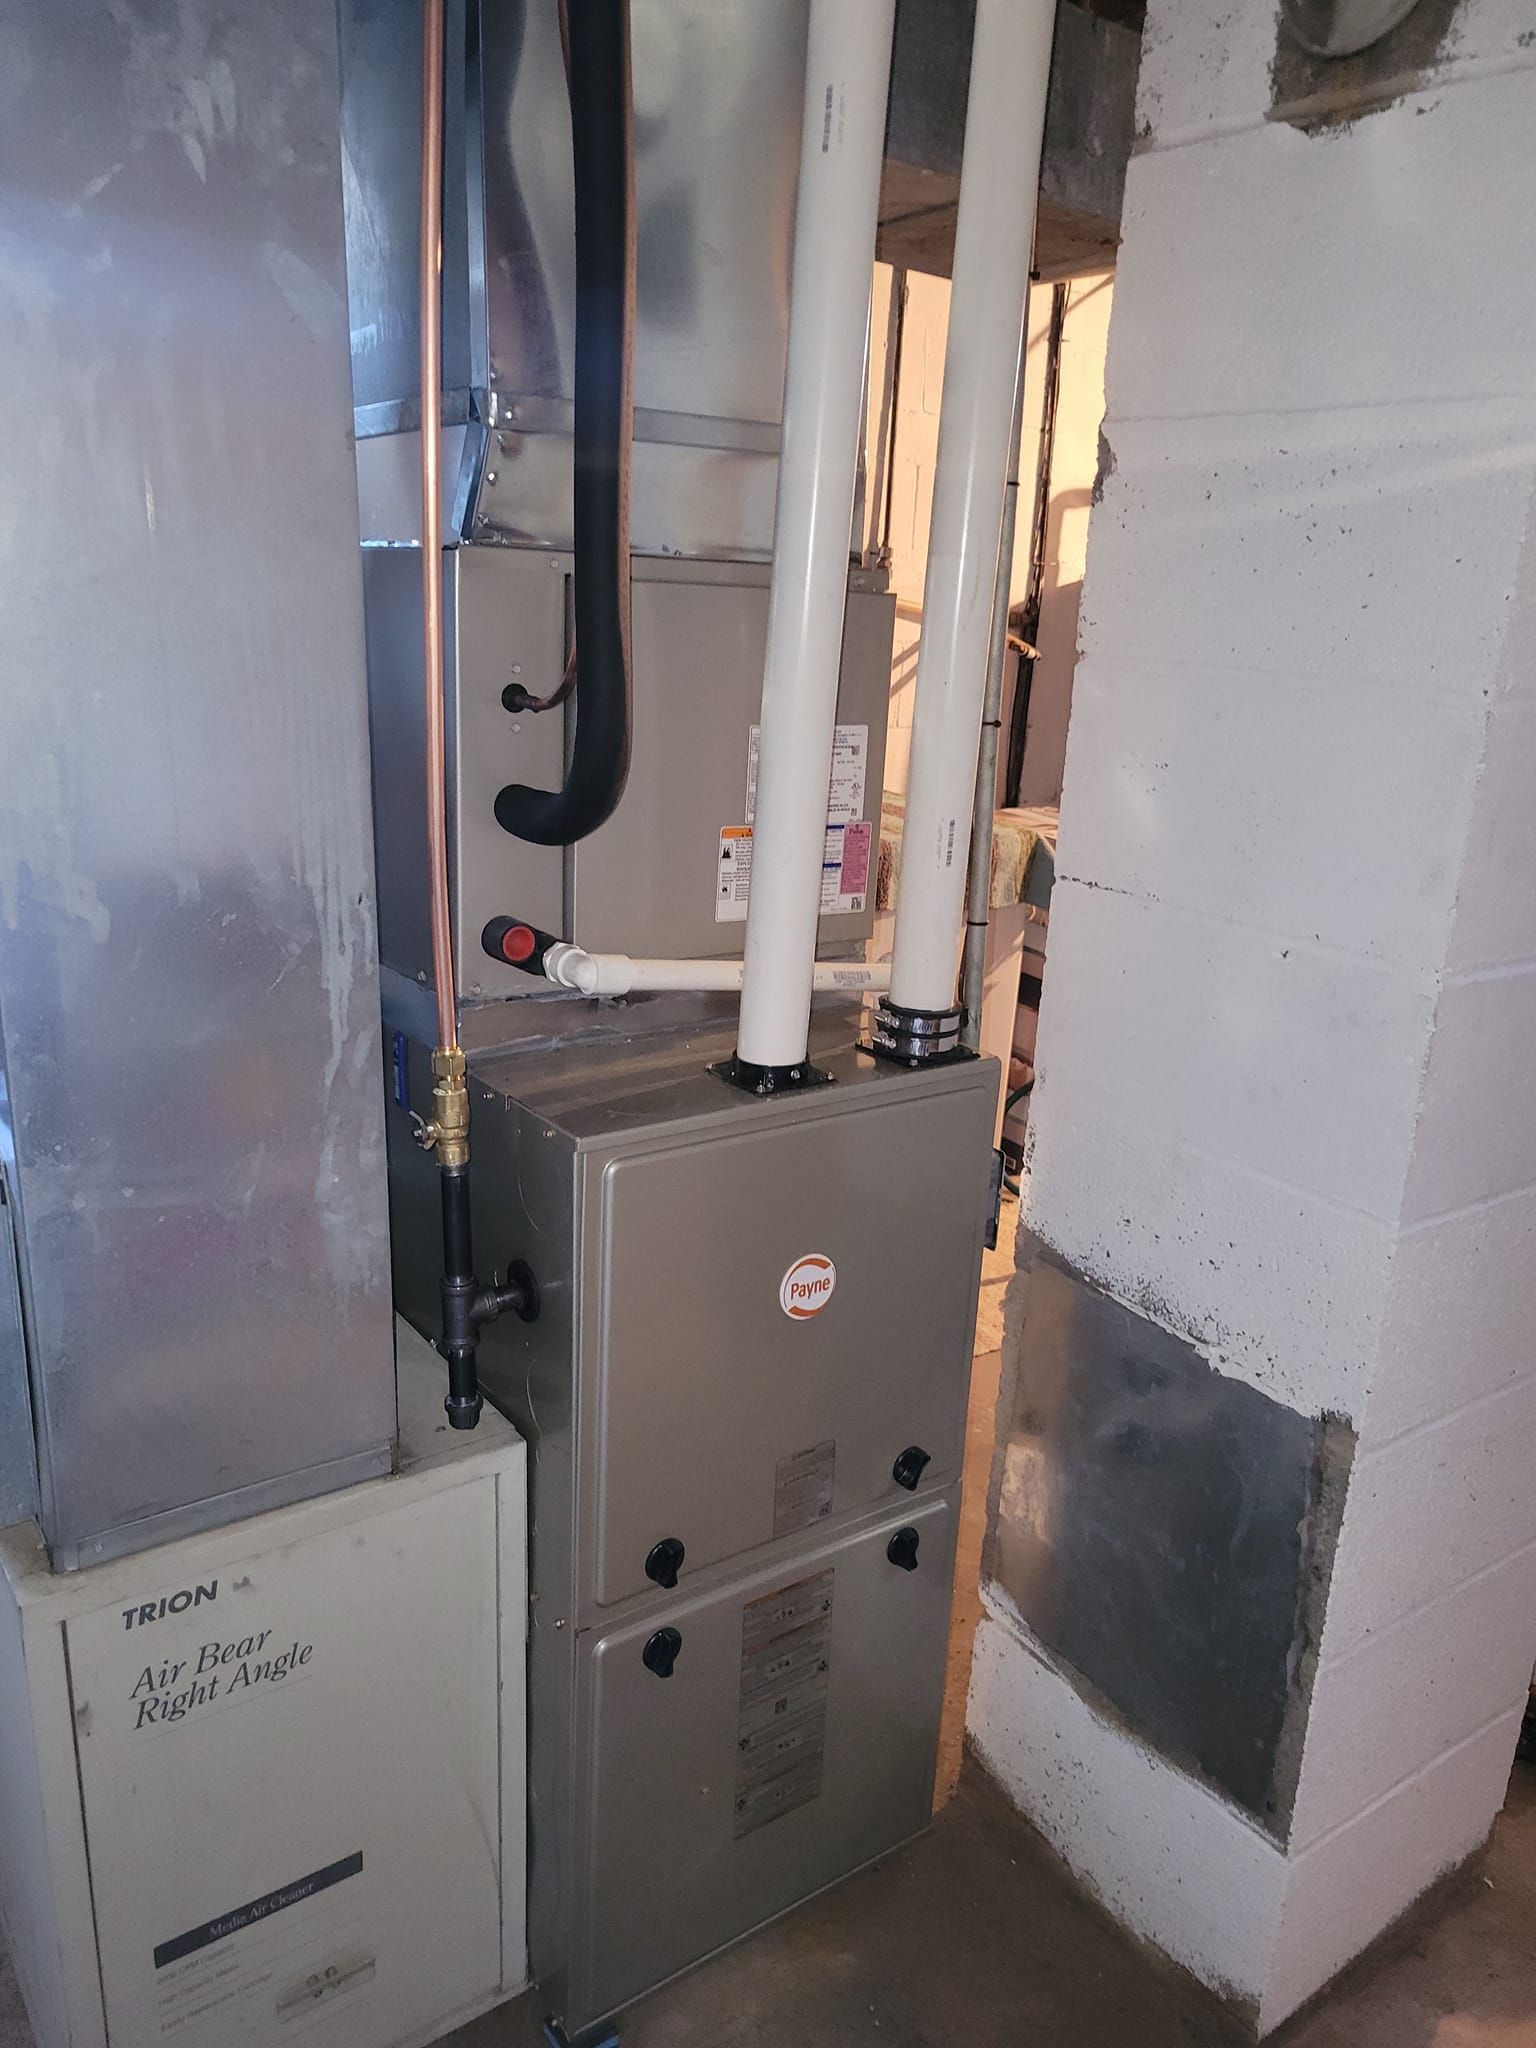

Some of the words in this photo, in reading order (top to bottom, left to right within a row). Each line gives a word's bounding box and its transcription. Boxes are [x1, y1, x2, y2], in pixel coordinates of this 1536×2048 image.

[790, 1277, 831, 1301] Payne
[122, 1579, 218, 1631] TRION
[128, 1659, 187, 1700] Air
[194, 1629, 272, 1676] Bear
[133, 1675, 220, 1730] Right
[226, 1641, 313, 1695] Angle
[209, 1913, 247, 1937] Media
[248, 1903, 268, 1921] Air
[269, 1882, 315, 1909] Cleaner
